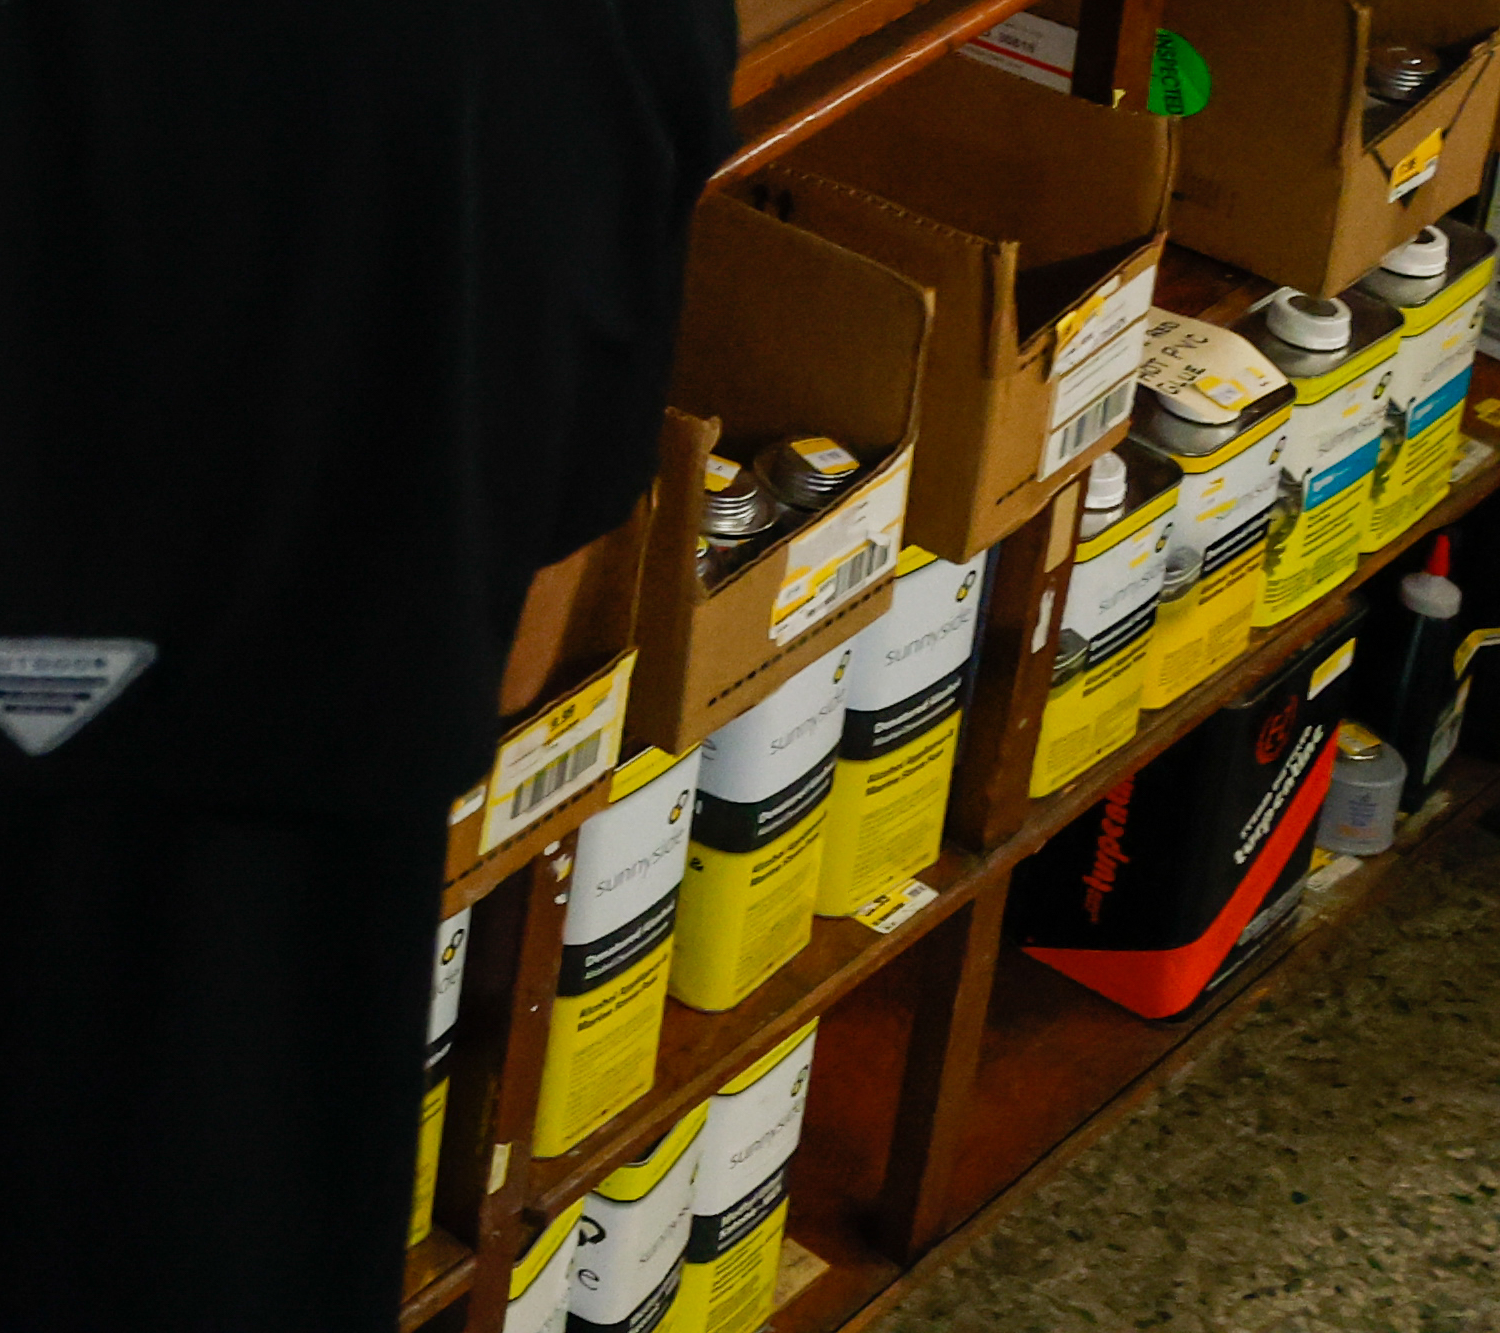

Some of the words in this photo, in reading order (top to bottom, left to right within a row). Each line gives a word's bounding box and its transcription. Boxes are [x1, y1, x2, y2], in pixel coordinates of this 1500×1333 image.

[1155, 33, 1186, 116] INSPECTED
[1169, 331, 1210, 362] PVC
[1156, 365, 1207, 395] GLUE
[884, 606, 972, 667] sunnyside
[1233, 724, 1325, 865] turpentine
[595, 826, 686, 897] sunnyside
[585, 925, 639, 967] Denatured
[578, 986, 615, 1018] Alcohol
